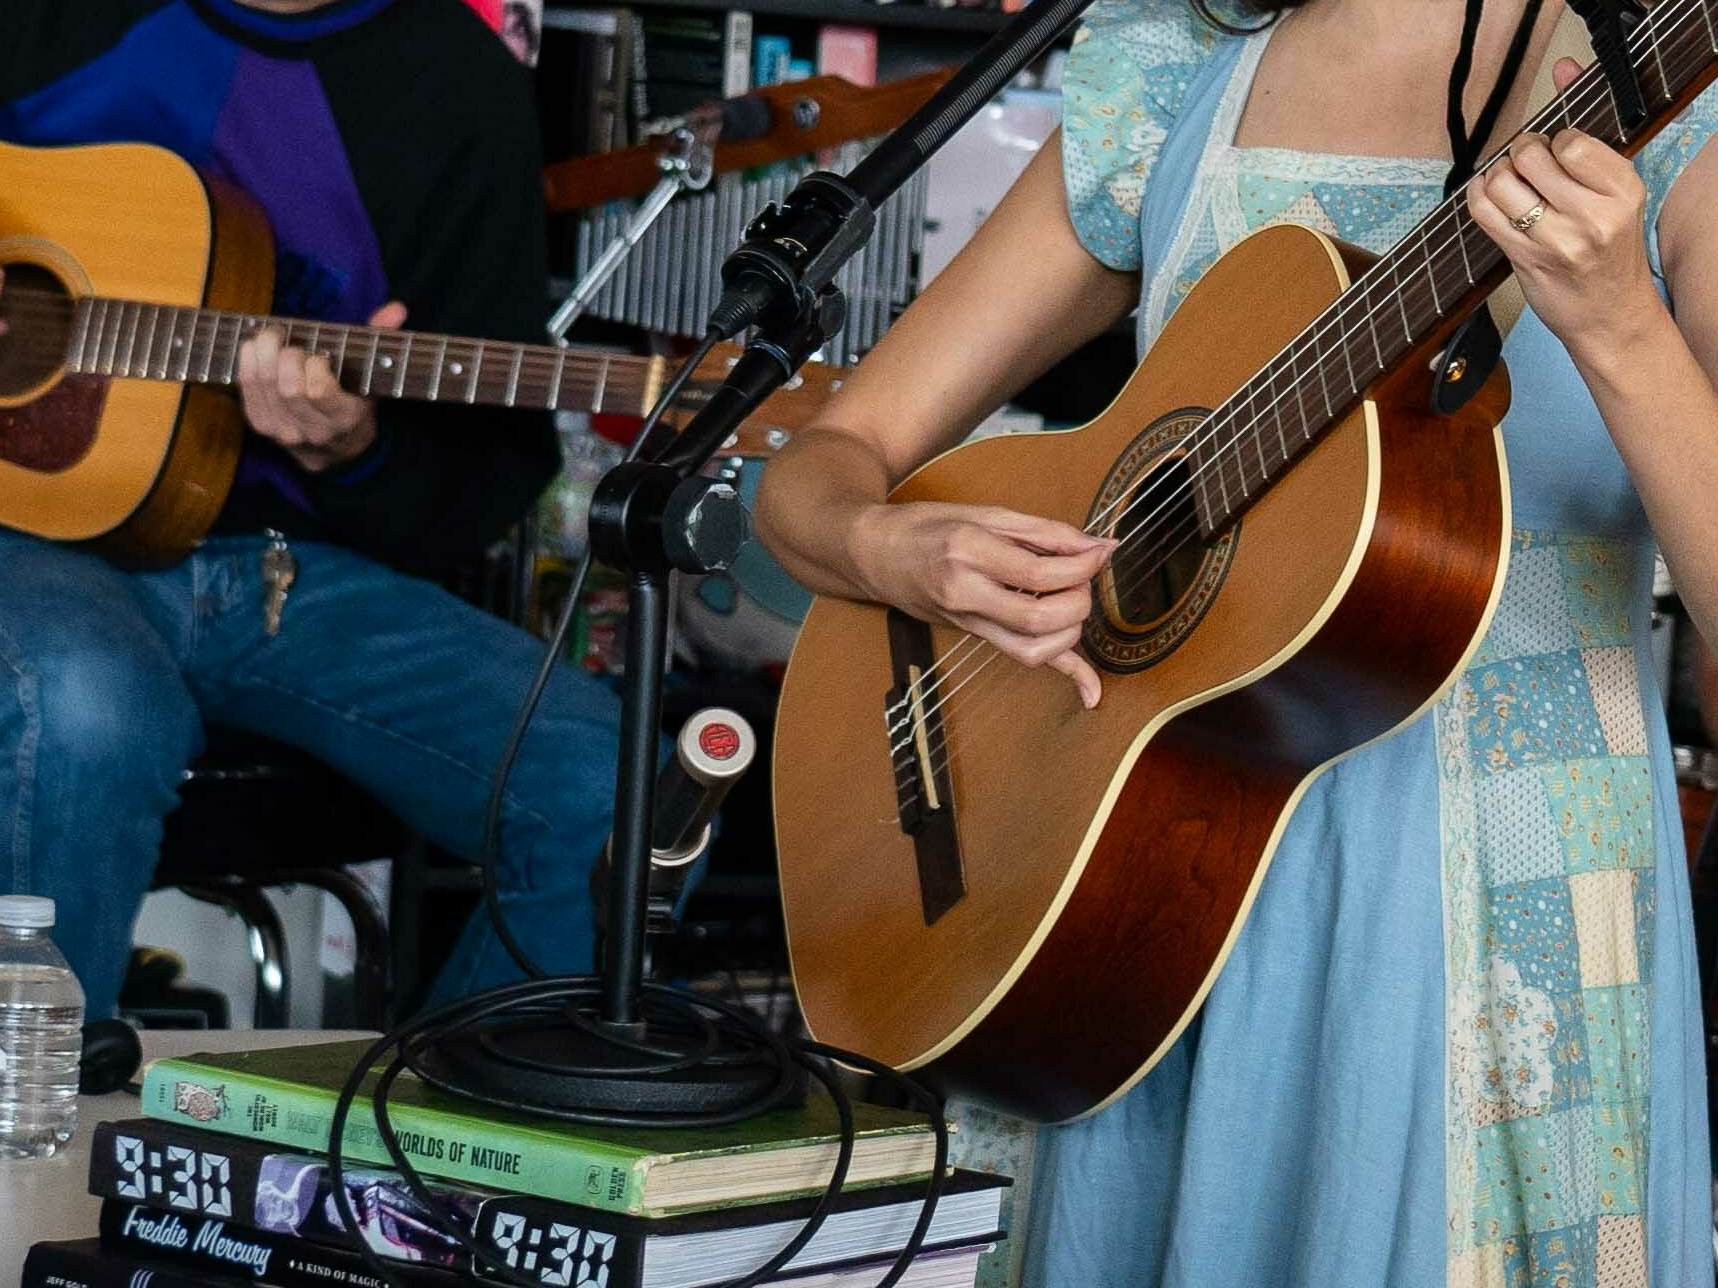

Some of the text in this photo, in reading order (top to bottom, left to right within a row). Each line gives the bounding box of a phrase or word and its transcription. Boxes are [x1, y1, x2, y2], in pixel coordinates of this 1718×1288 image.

[448, 1139, 522, 1175] OF NATURE
[116, 1134, 232, 1218] 9:30
[123, 1202, 271, 1276] Freddie Mercury
[46, 1275, 66, 1287] JEFF
[305, 1262, 331, 1278] KIND
[333, 1268, 346, 1281] OF
